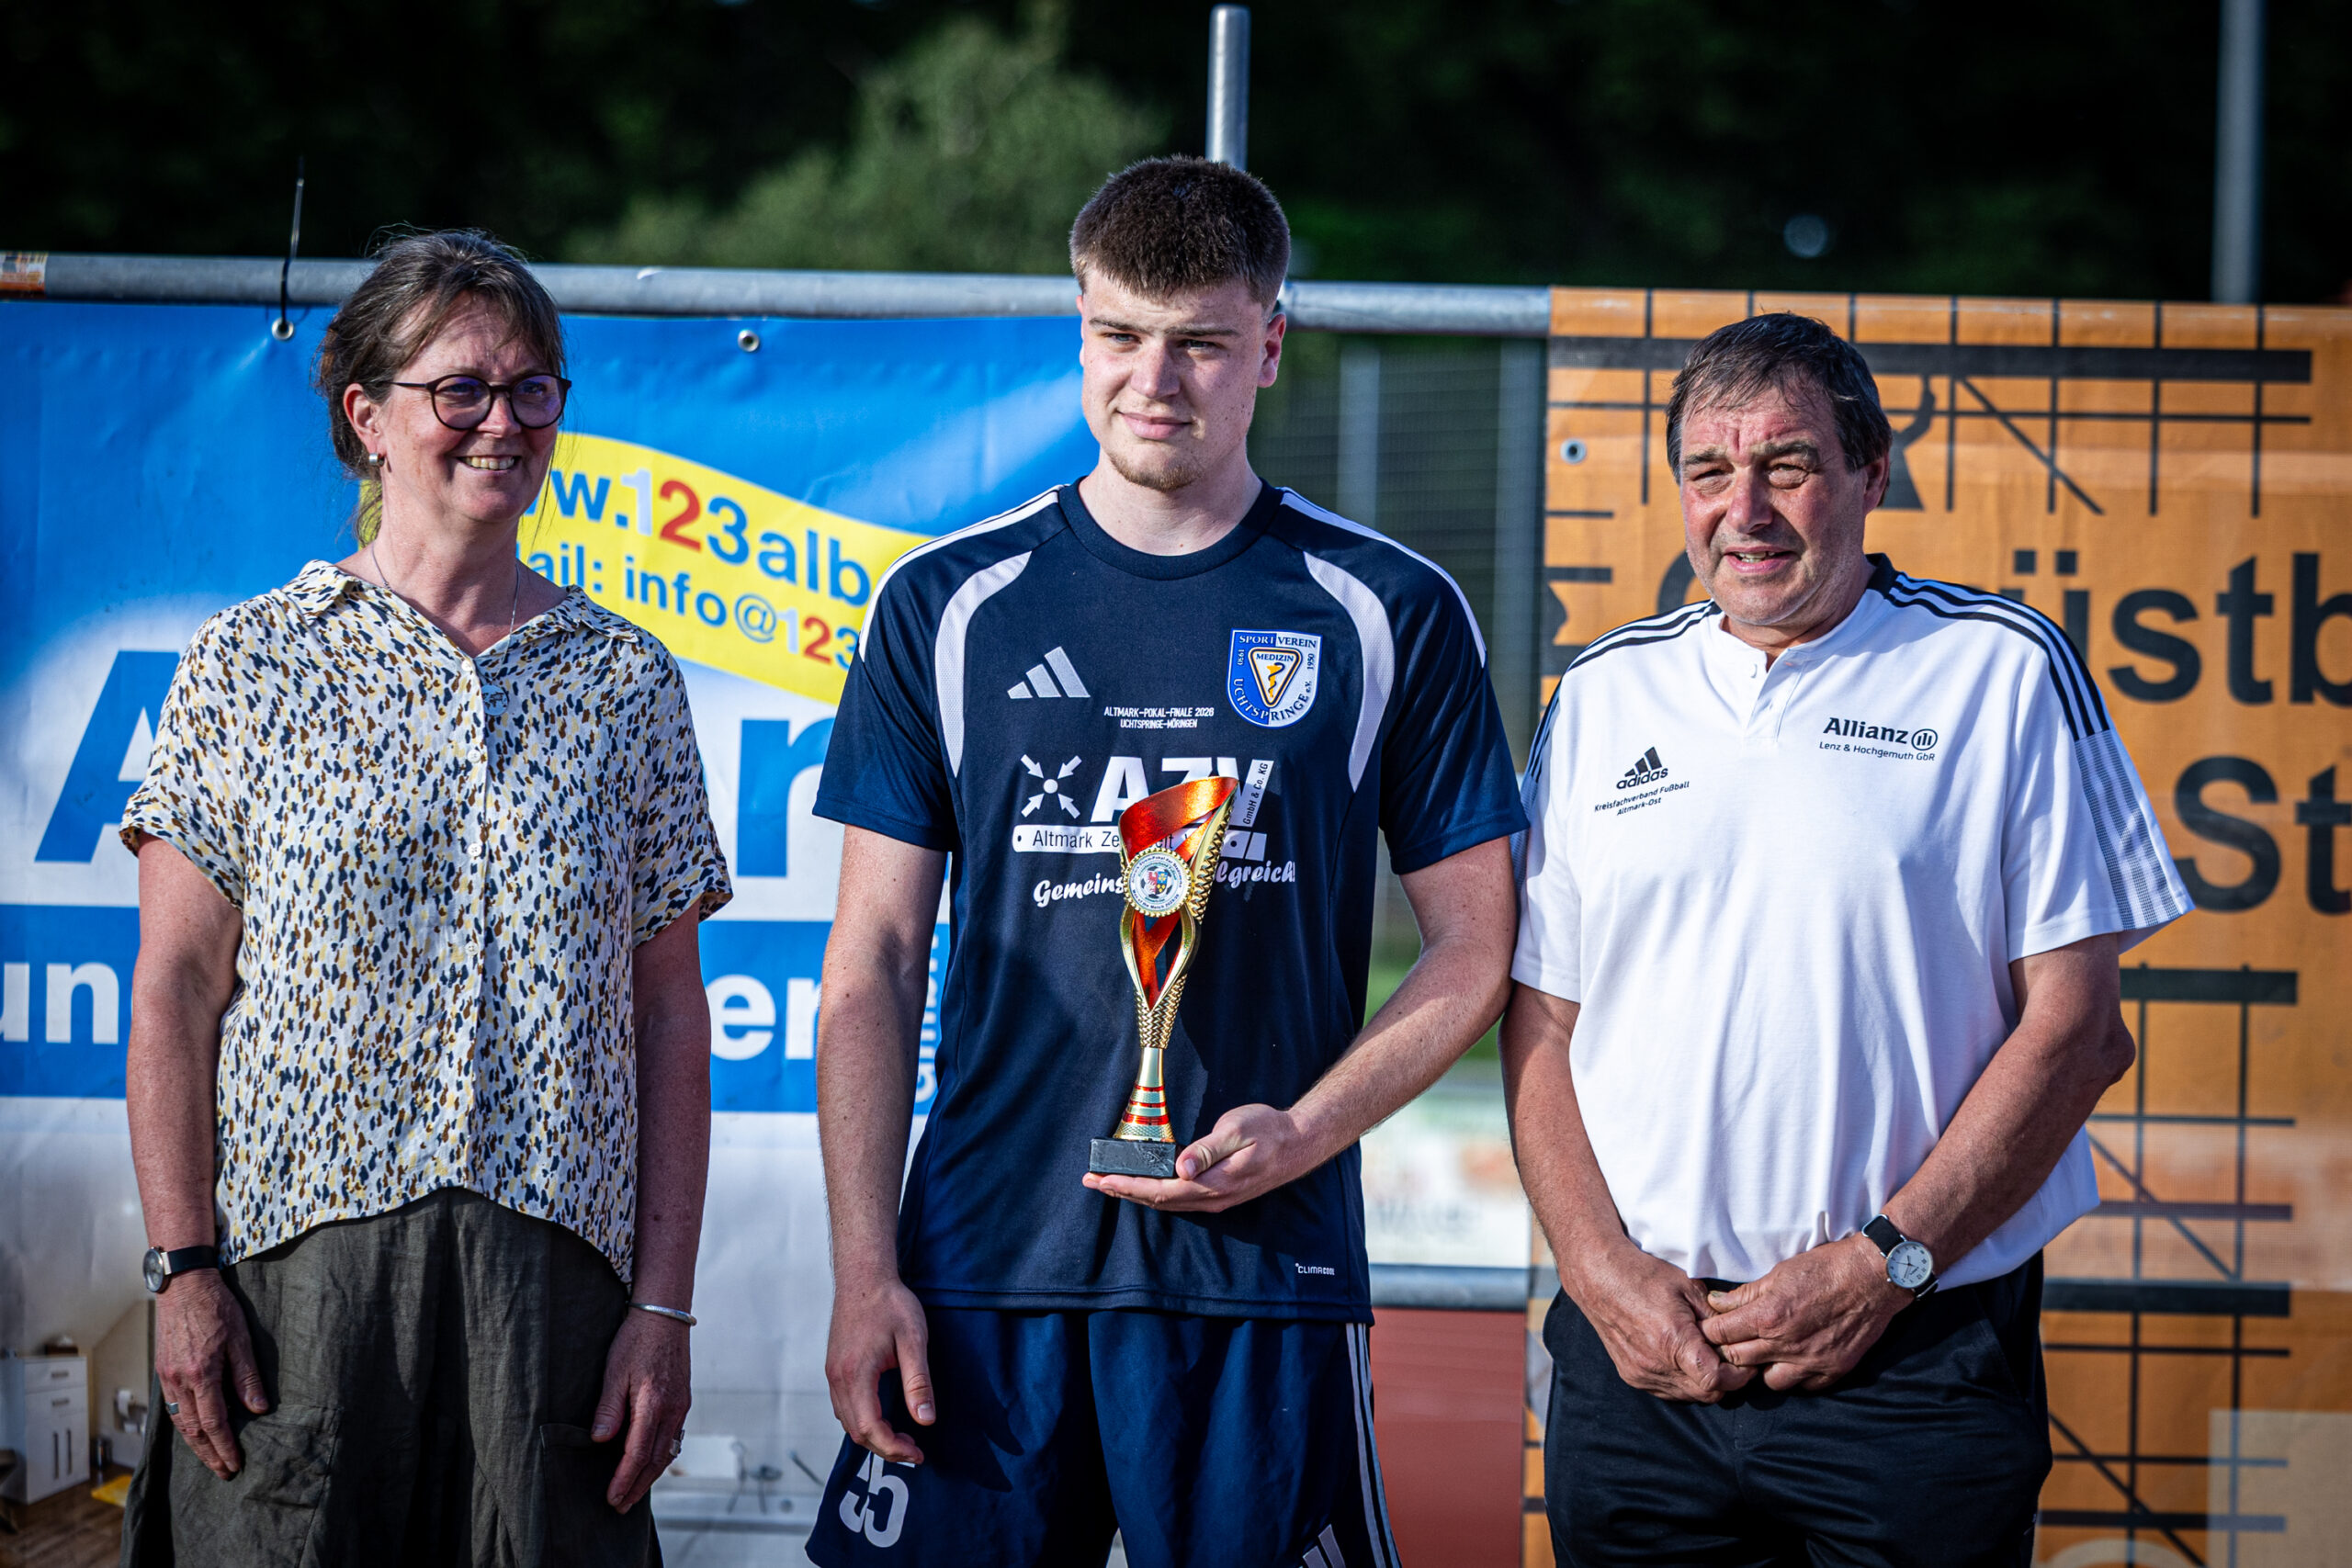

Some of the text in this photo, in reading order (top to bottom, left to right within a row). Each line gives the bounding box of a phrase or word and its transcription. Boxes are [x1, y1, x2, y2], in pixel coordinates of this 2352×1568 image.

[516, 541, 602, 592] ail:
[1238, 635, 1317, 648] SPORT VEREIN
[1256, 653, 1295, 662] MEDIZIN
[1233, 678, 1308, 721] UCHTSPRINGE
[1103, 706, 1193, 717] ALTMARK-POKAL-FINALE
[1823, 716, 1909, 745] Allianz
[1819, 741, 1936, 761] Lenz & Hochgemuth GbR
[1616, 768, 1668, 790] adidas
[1243, 800, 1258, 825] GmbH
[1258, 762, 1268, 775] KG
[1594, 781, 1690, 813] Kreisfachverband Fußball
[1616, 796, 1662, 816] Altmark-Ost
[1033, 829, 1092, 849] Altmark
